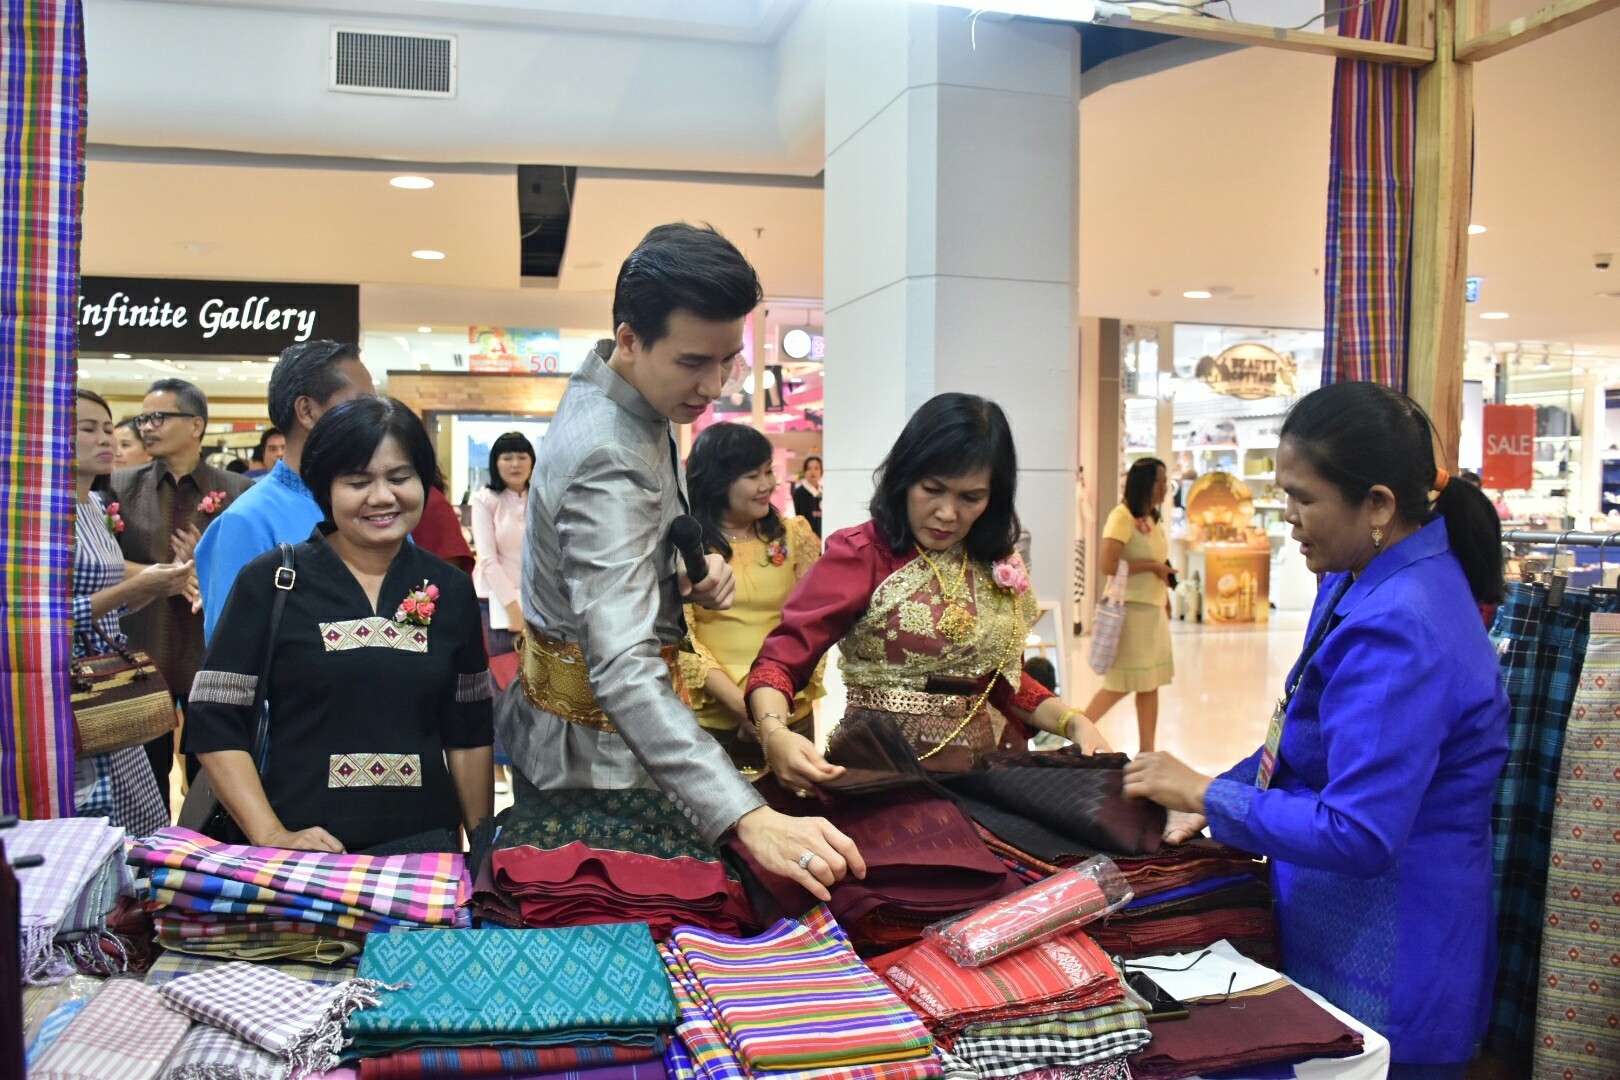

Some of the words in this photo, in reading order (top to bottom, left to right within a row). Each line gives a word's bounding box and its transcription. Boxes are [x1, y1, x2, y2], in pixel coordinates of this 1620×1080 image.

[199, 296, 317, 342] Gallery
[530, 355, 557, 373] 50
[1486, 433, 1531, 456] SALE
